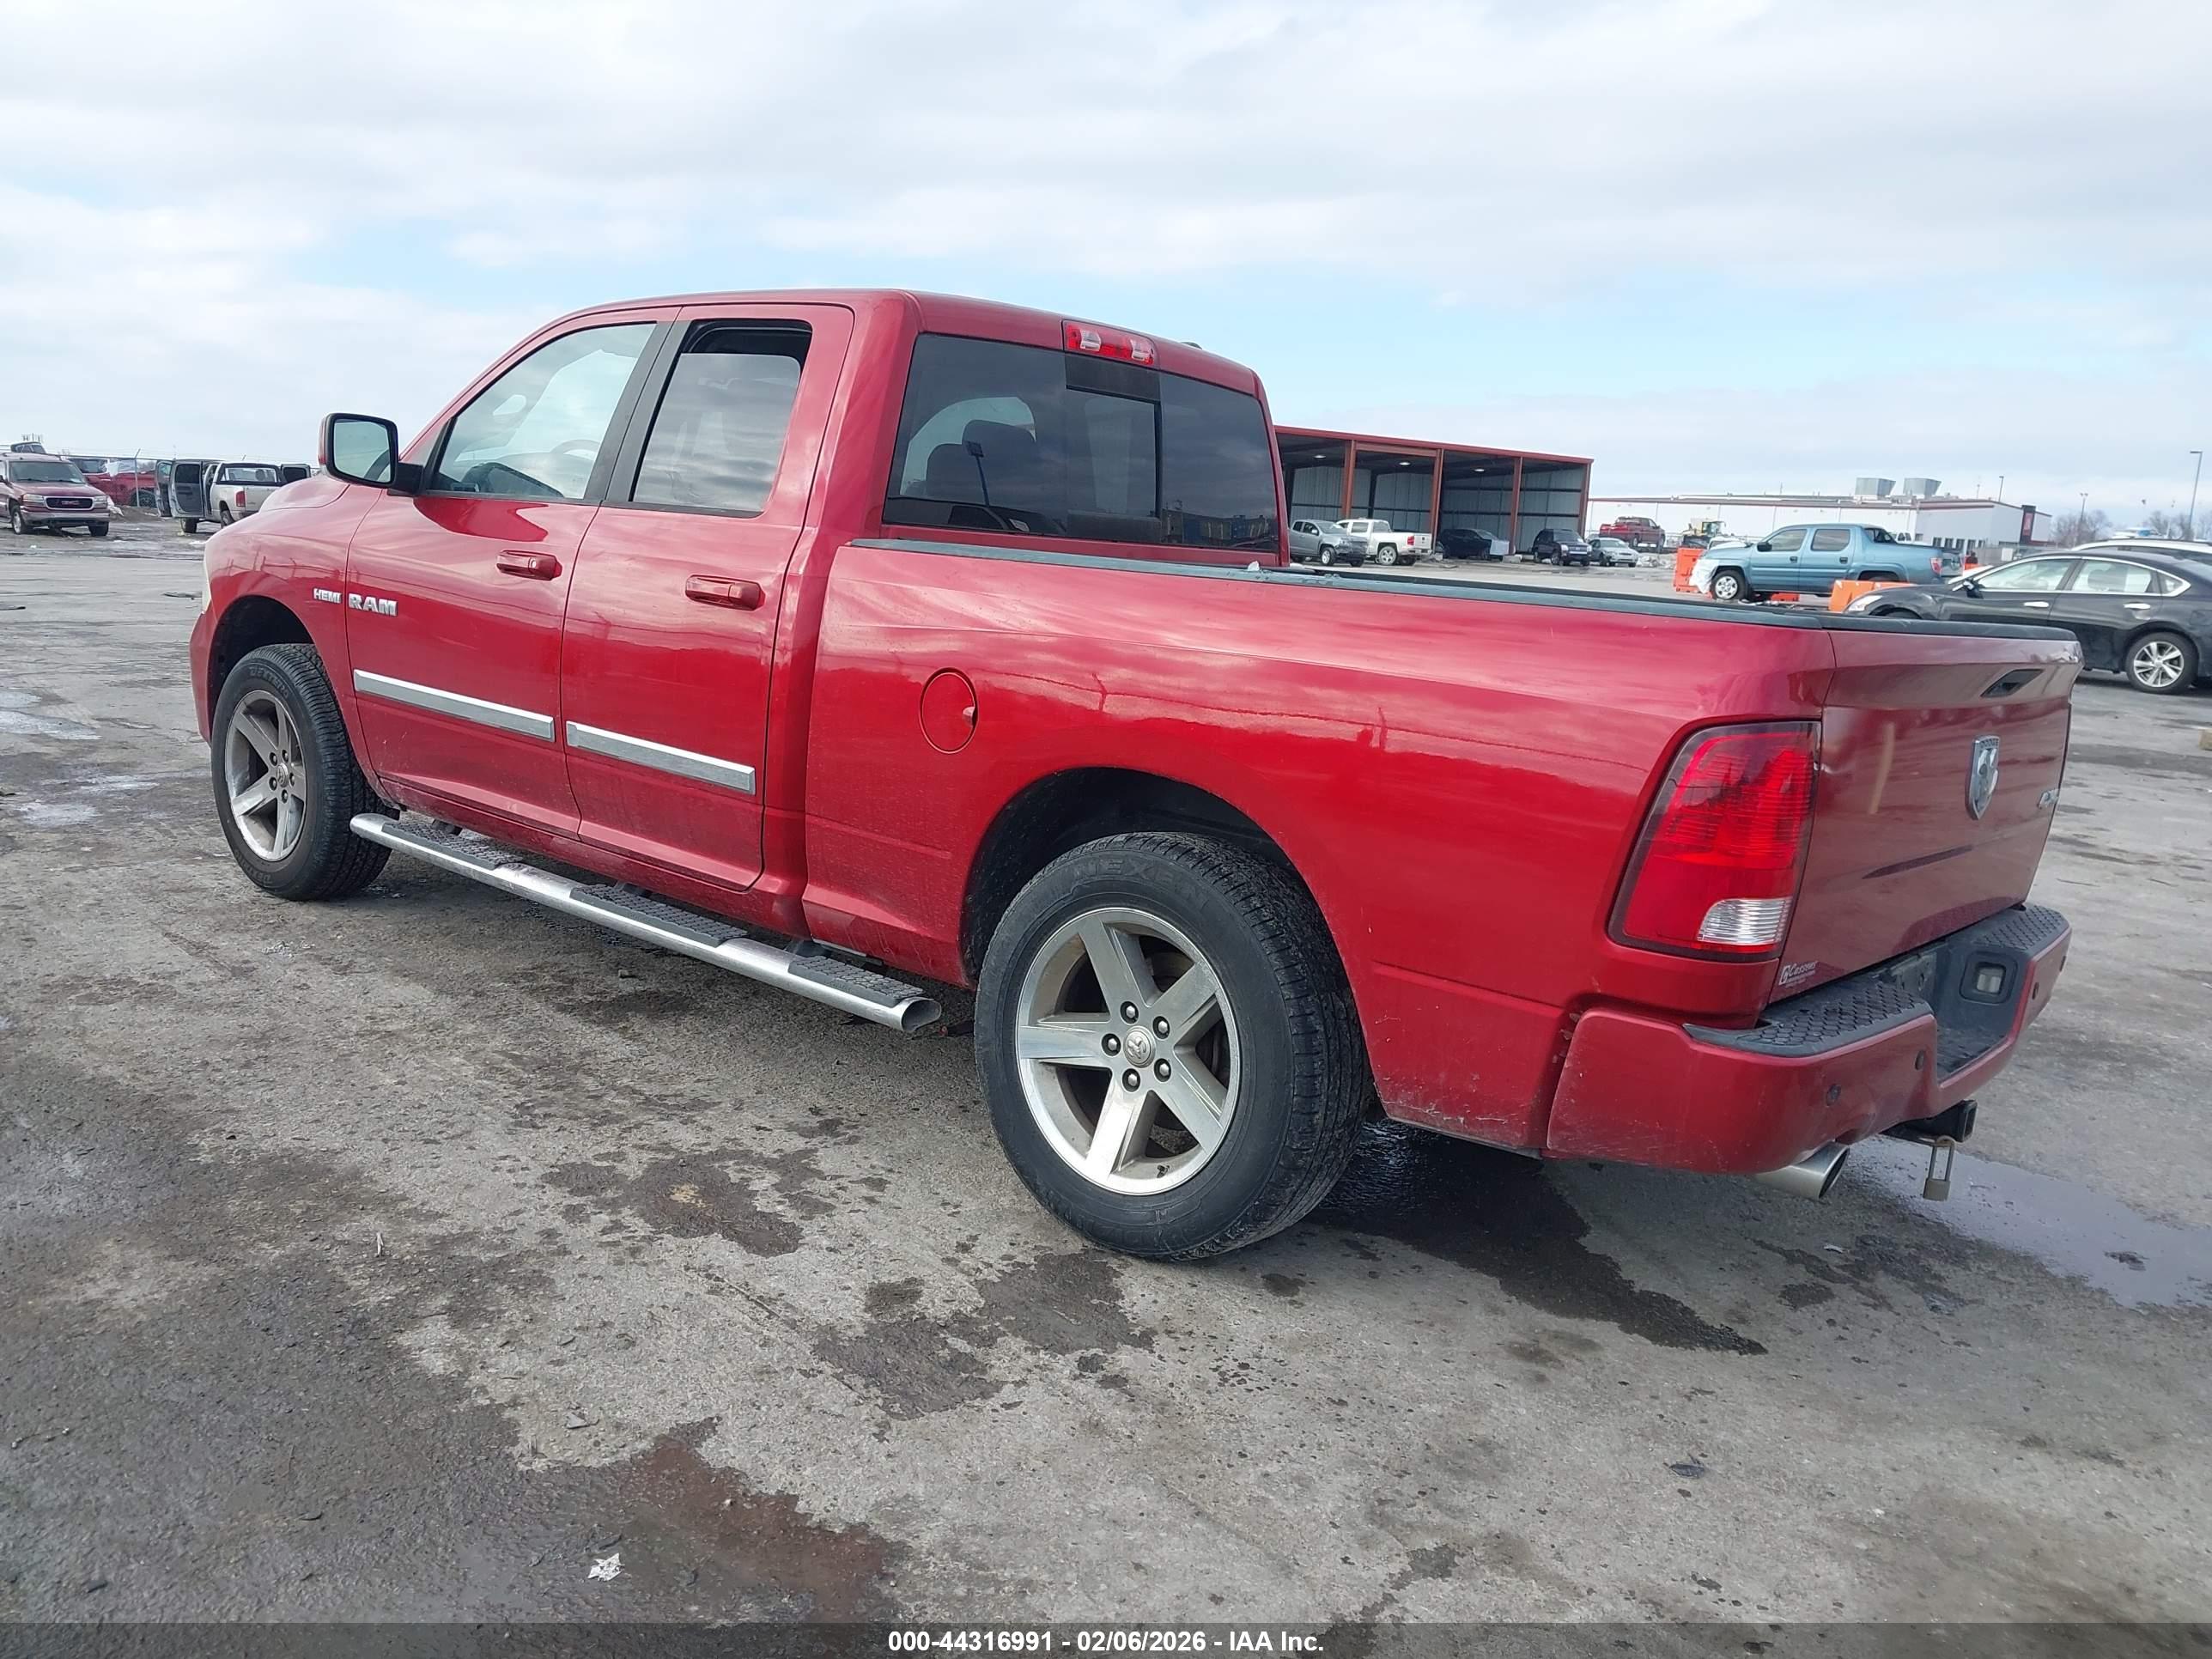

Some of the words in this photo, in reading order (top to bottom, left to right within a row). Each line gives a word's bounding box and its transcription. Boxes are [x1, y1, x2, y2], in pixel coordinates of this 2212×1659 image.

[313, 587, 342, 604] HEMI
[348, 592, 398, 617] RAM
[1079, 859, 1208, 908] NEXEN
